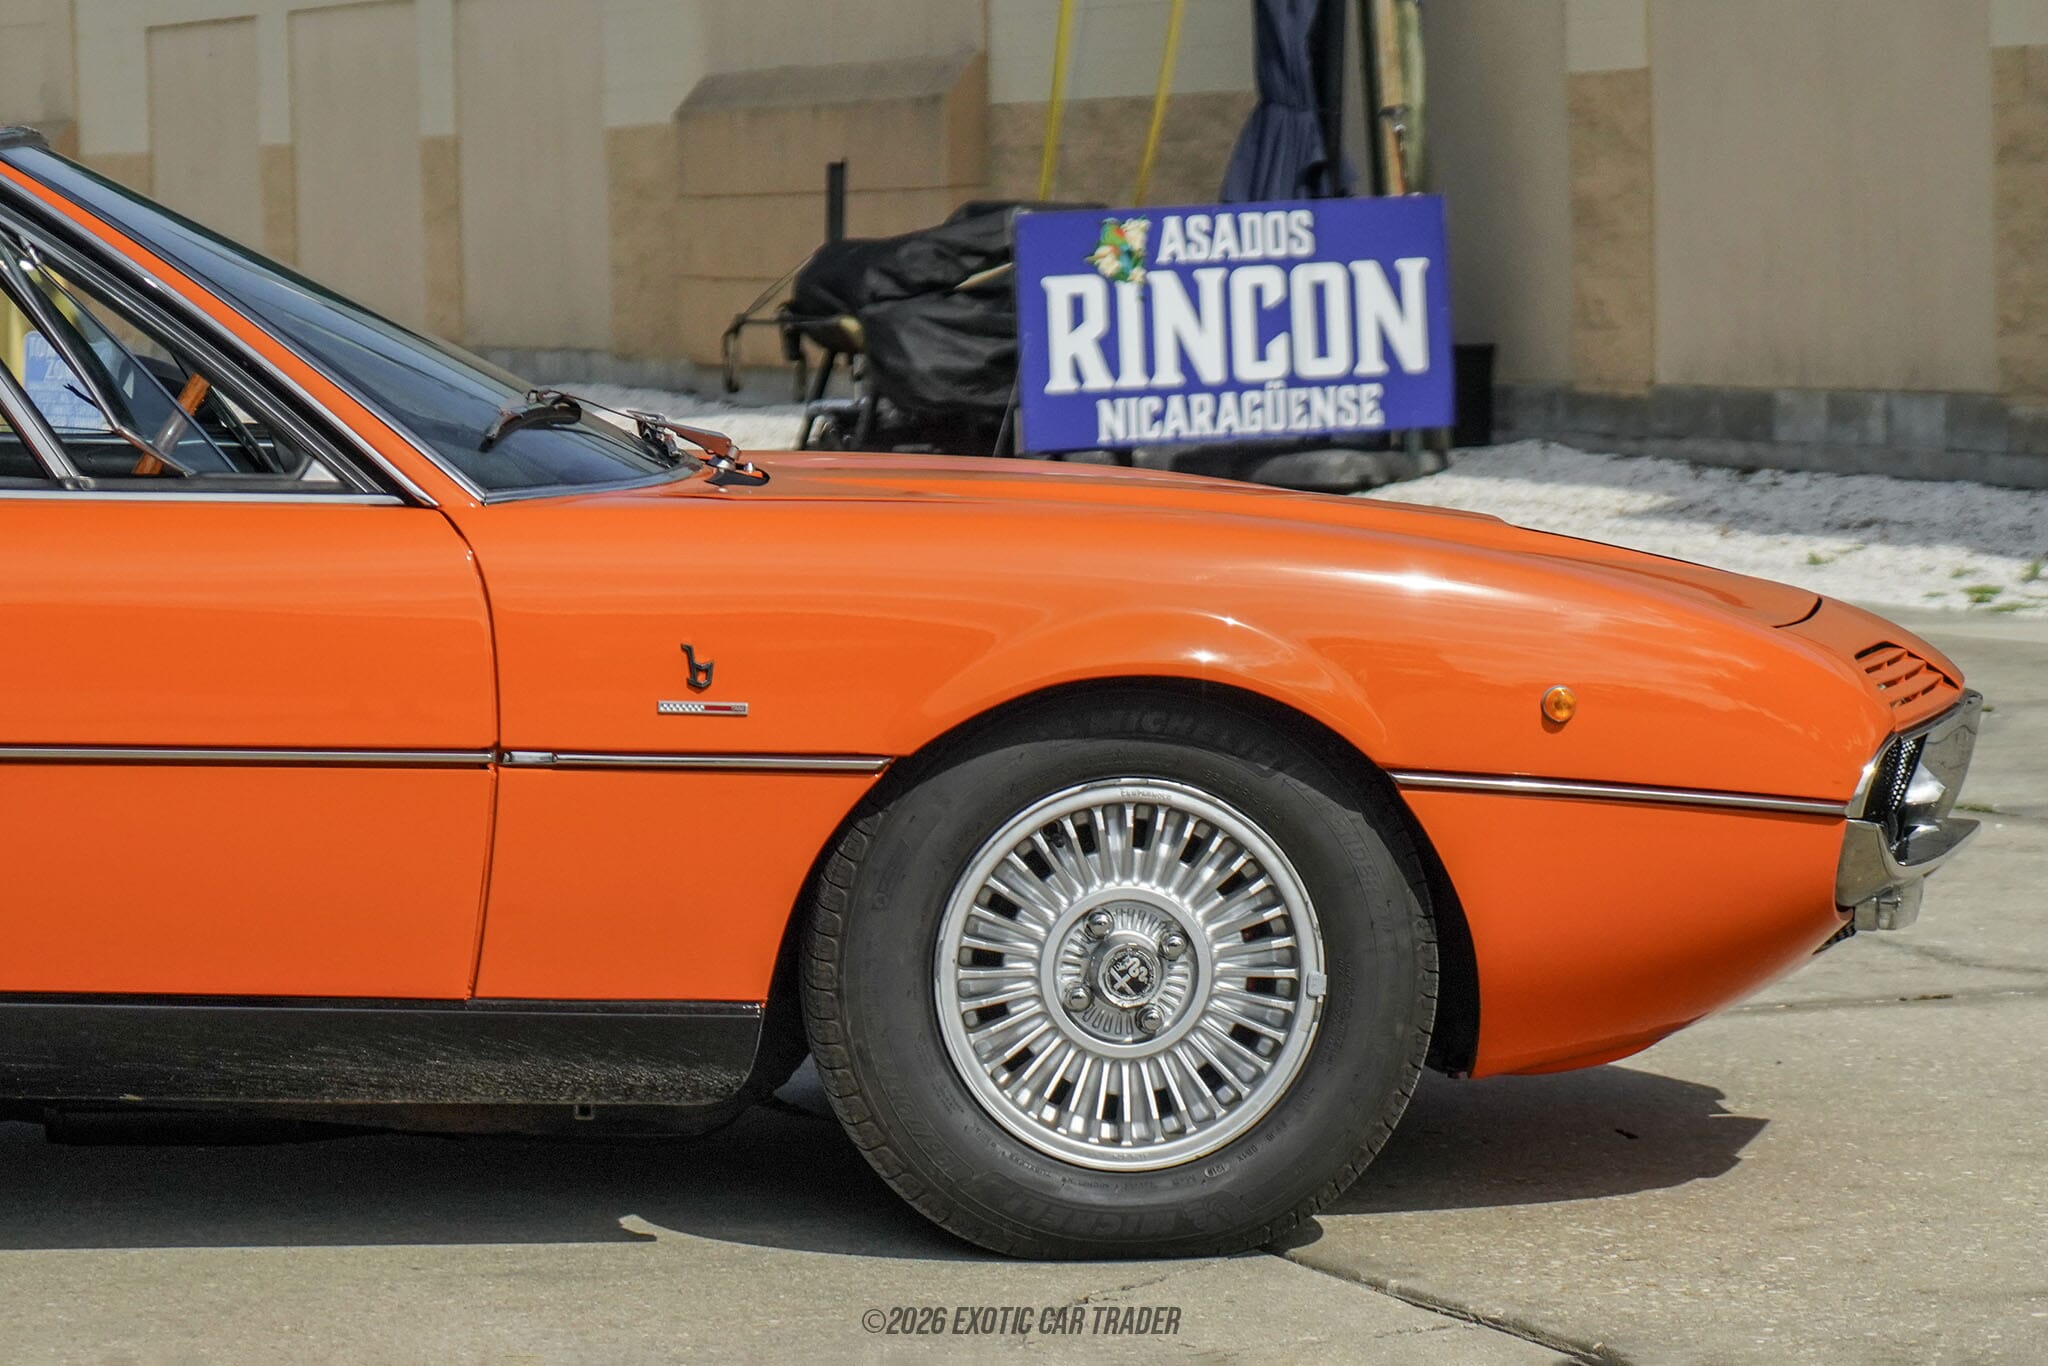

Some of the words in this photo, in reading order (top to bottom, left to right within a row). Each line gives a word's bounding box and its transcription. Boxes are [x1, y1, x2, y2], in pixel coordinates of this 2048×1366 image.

[1155, 209, 1317, 265] ASADOS
[1040, 256, 1431, 395] RINCON
[1097, 380, 1385, 443] NICARAGÜENSE
